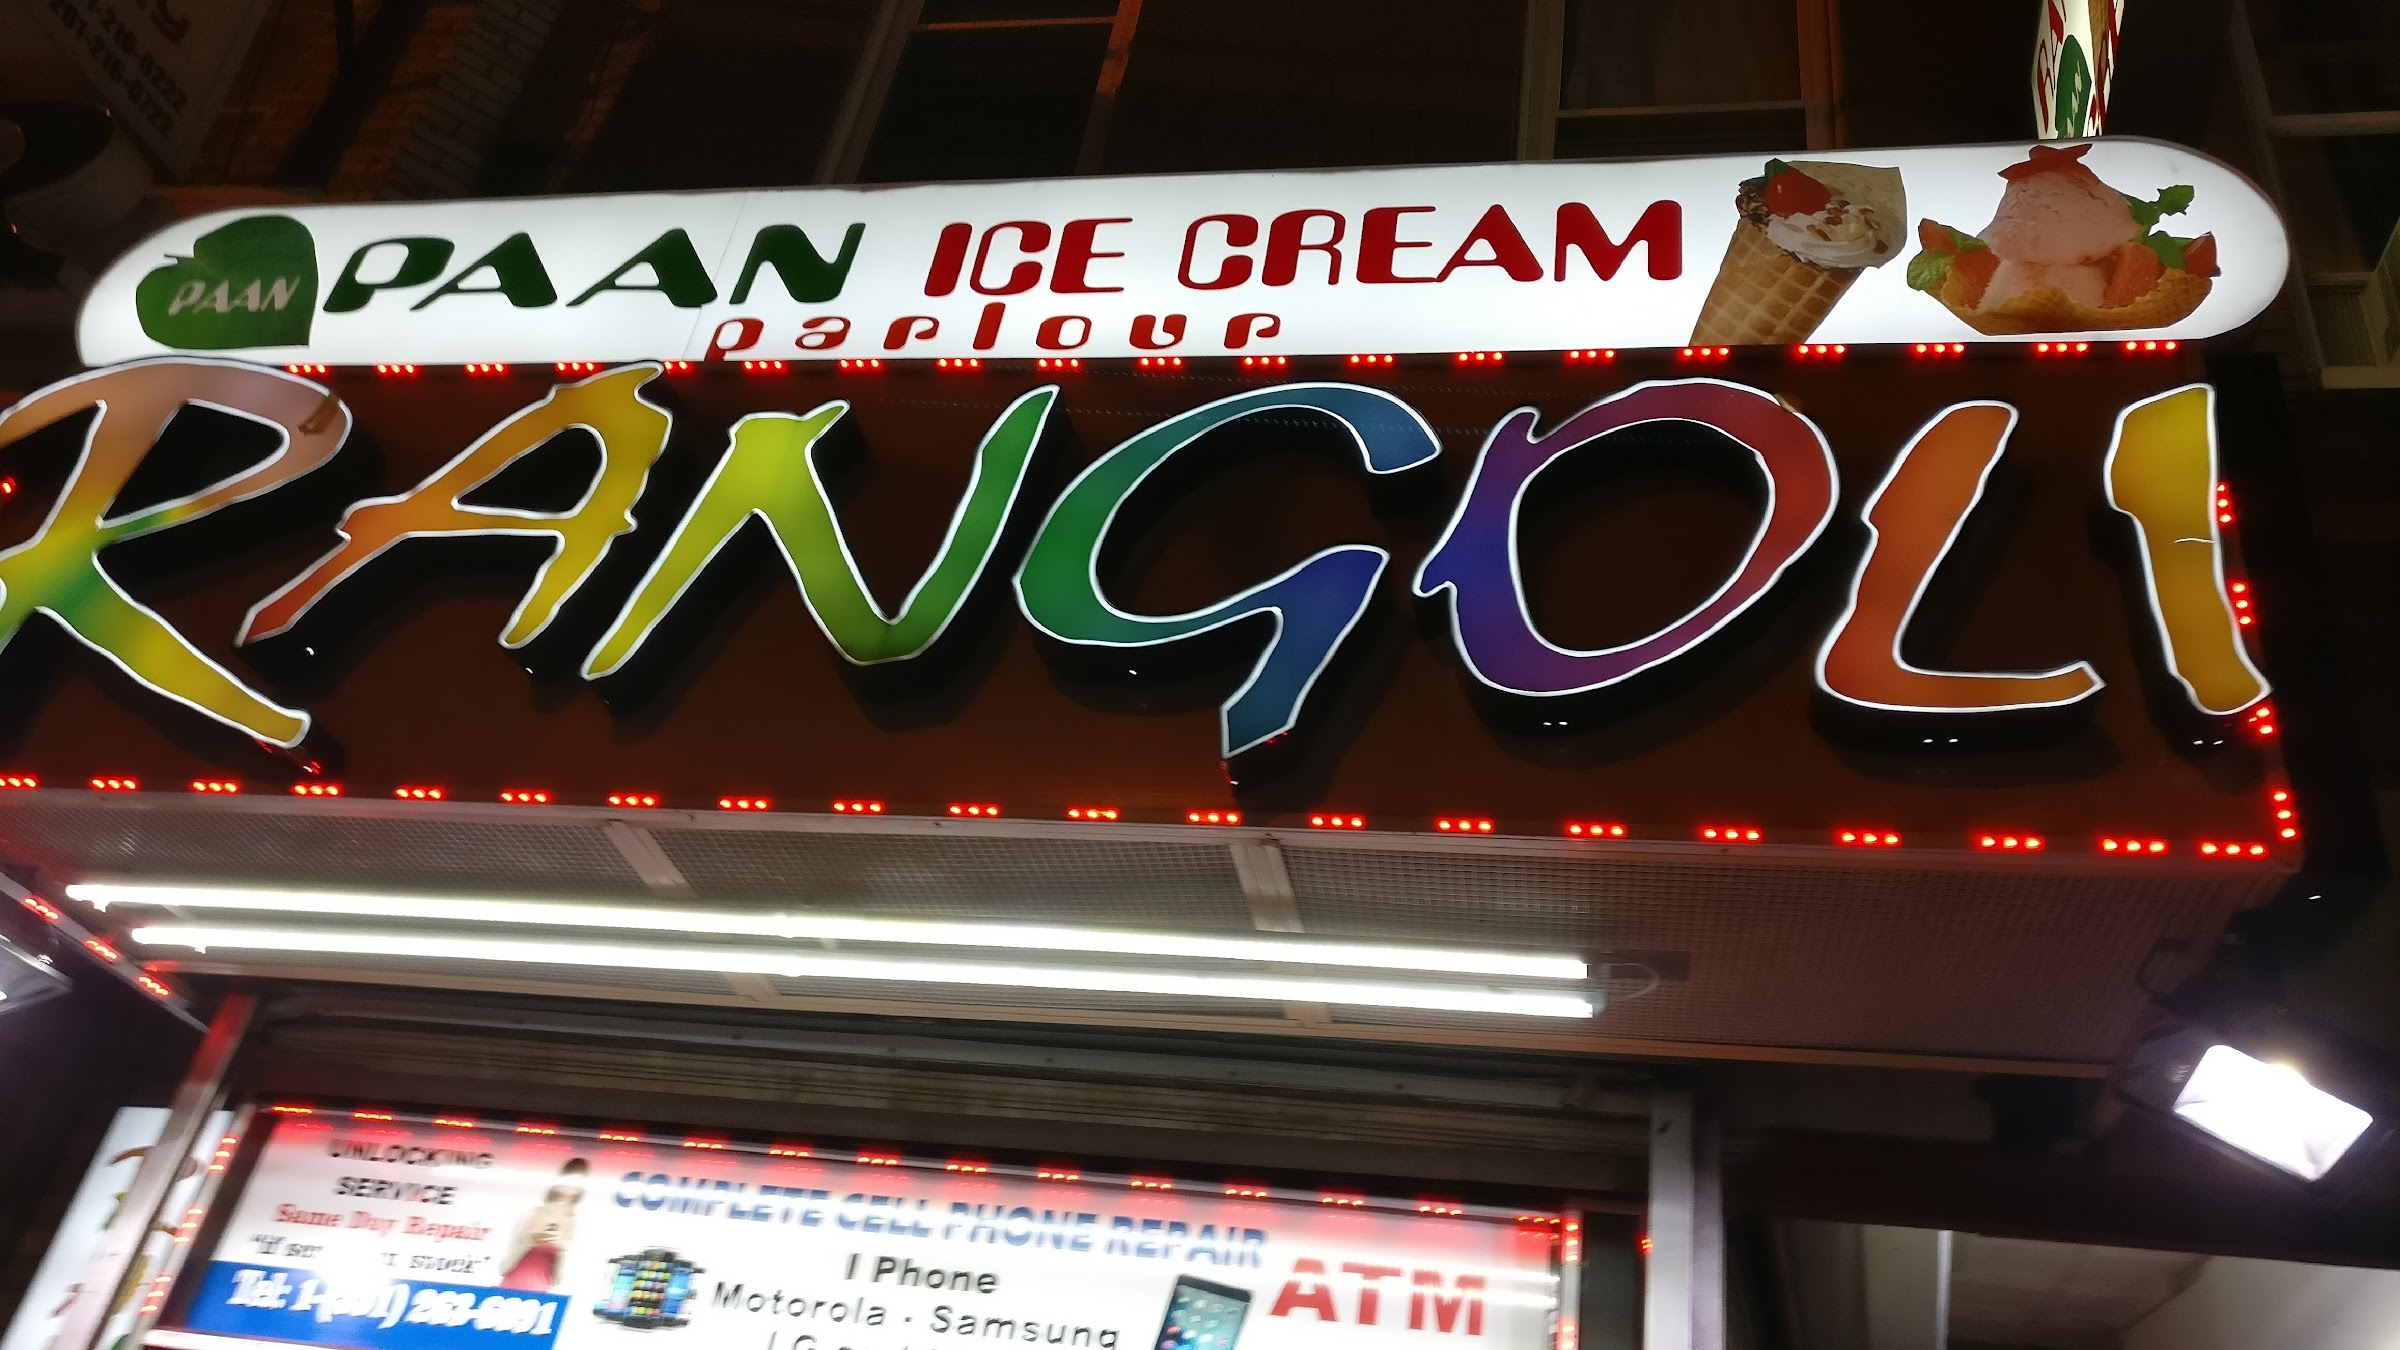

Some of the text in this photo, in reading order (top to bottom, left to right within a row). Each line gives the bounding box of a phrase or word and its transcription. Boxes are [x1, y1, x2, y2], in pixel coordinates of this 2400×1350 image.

[323, 199, 1684, 313] PAAN ICE CREAM
[168, 276, 300, 317] PAAN
[704, 302, 1281, 361] parlour
[0, 354, 2270, 758] RANGOLI
[327, 1138, 495, 1170] UNLOCKING
[333, 1176, 458, 1205] SERVICE
[615, 1170, 1269, 1269] COMPLETE CELL PHONE REPAIR
[273, 1203, 494, 1243] Same Day Repair
[870, 1254, 1000, 1296] Phone
[1268, 1256, 1490, 1338] ATM
[711, 1280, 888, 1327] Motorola
[930, 1303, 1120, 1350] Samsung
